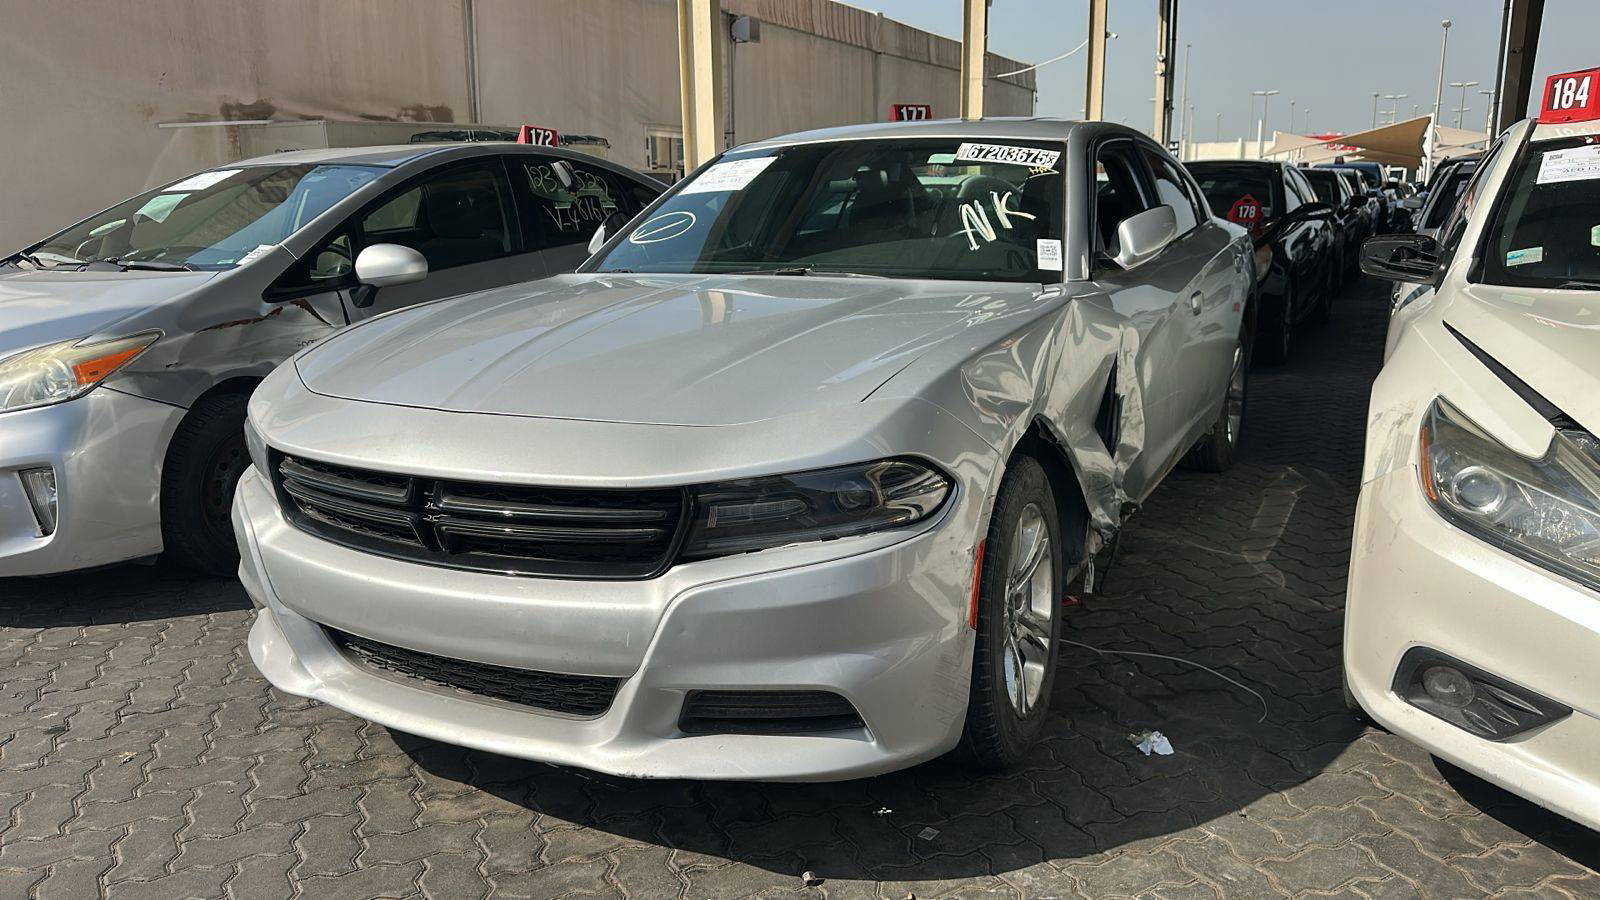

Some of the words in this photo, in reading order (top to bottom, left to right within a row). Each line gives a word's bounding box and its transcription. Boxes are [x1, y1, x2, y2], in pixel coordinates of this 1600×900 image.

[1552, 76, 1591, 110] 184
[901, 106, 926, 121] 177
[530, 128, 553, 147] 172
[967, 145, 1050, 166] 67203675
[1238, 205, 1256, 218] 178
